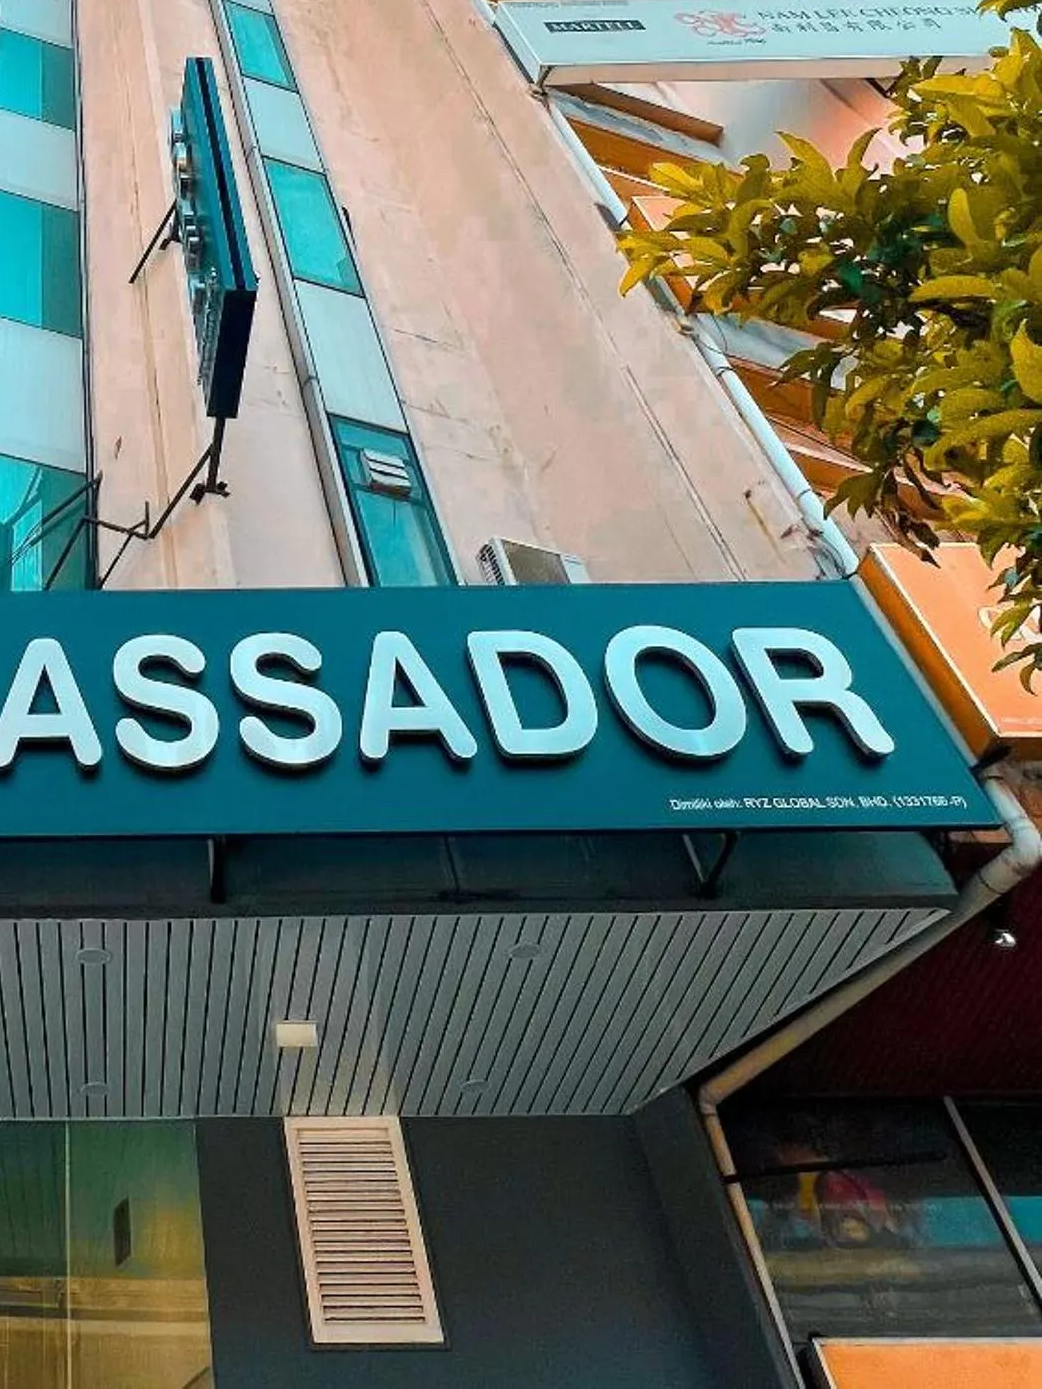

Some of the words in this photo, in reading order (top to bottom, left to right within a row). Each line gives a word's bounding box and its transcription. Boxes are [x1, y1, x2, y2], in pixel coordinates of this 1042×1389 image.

[758, 9, 811, 20] NAM
[548, 21, 642, 32] MARTELL
[743, 797, 772, 809] RYZ
[773, 796, 825, 809] GLOBAL
